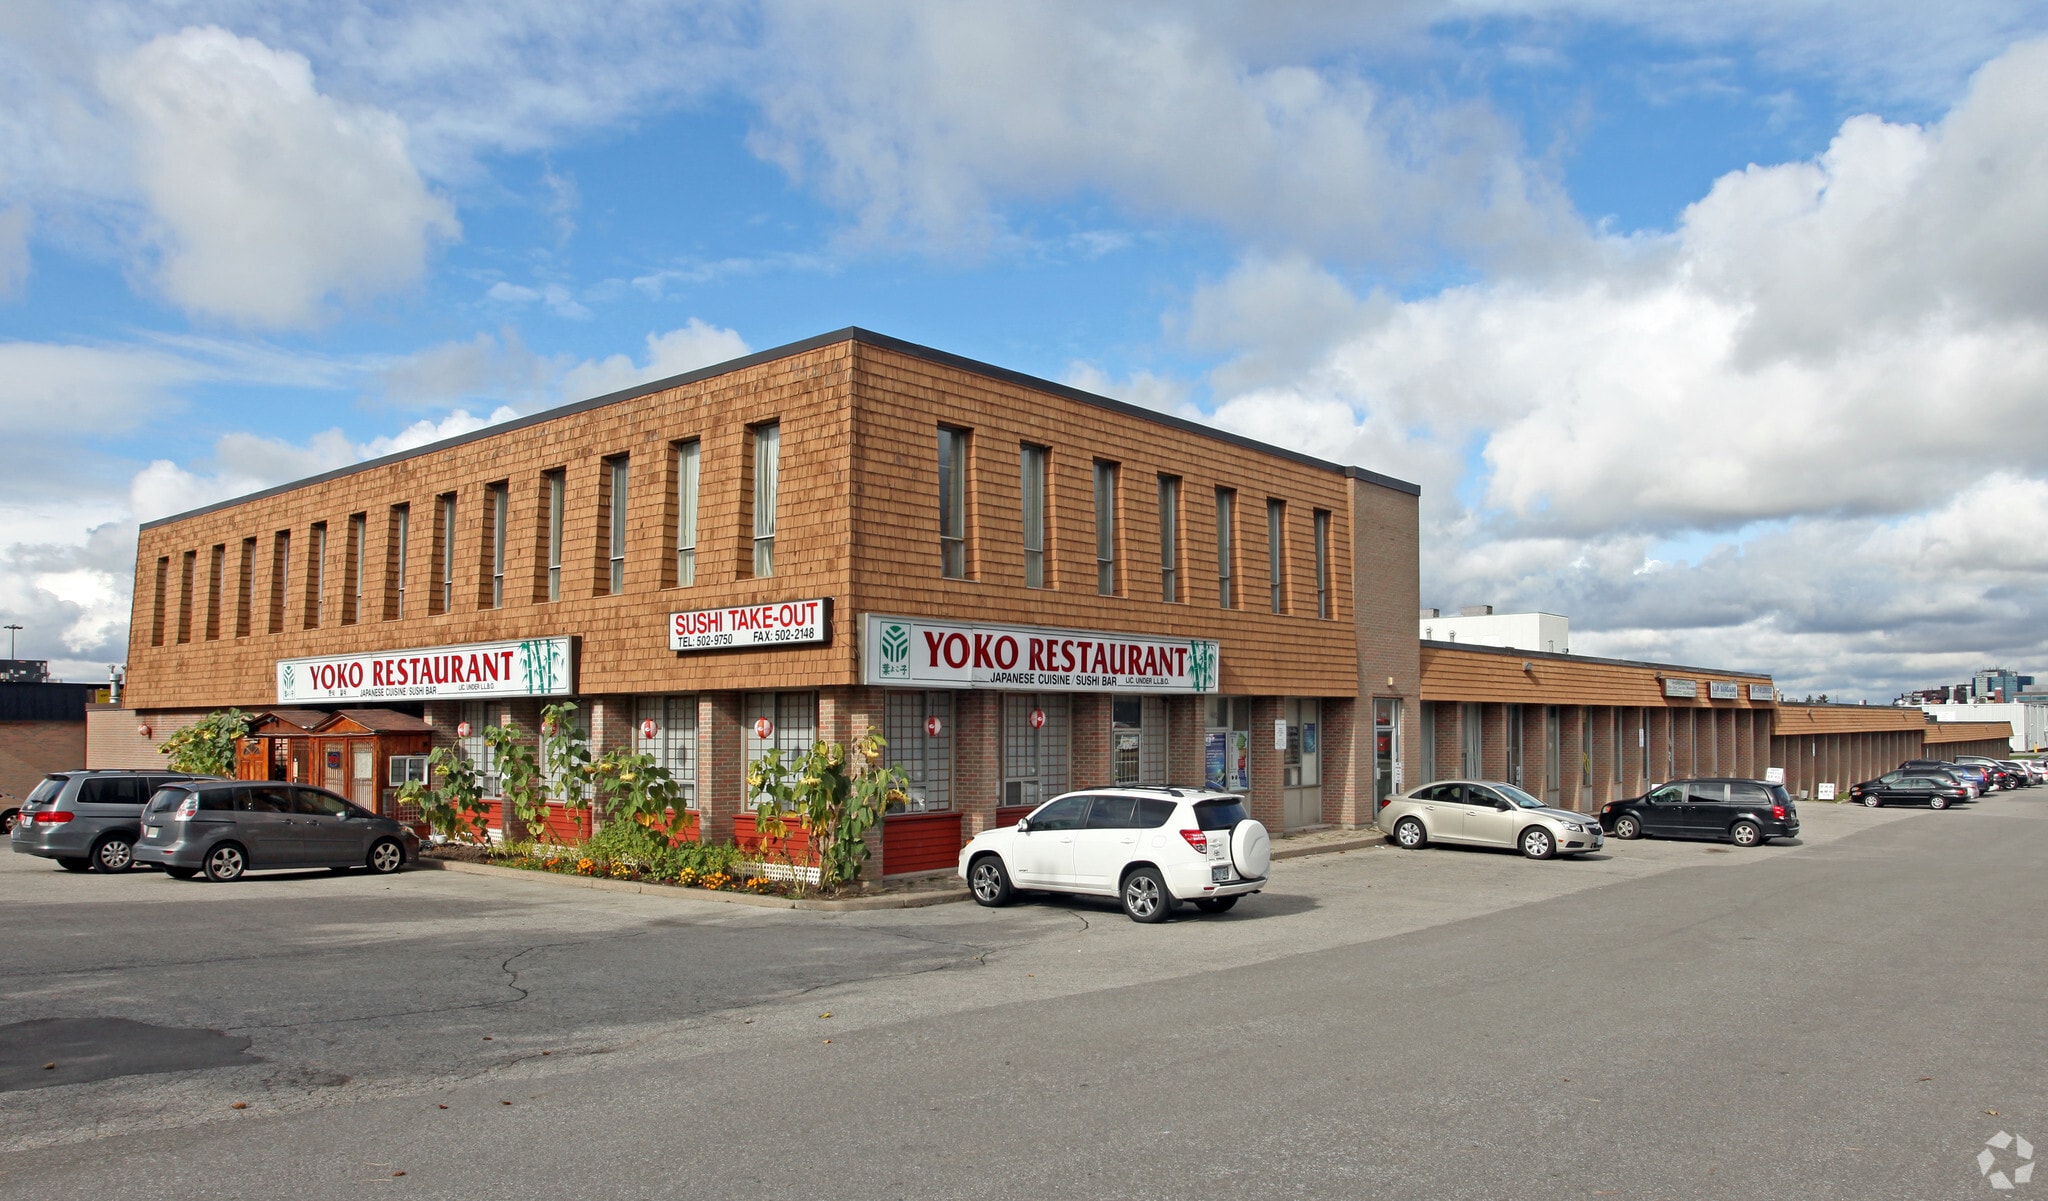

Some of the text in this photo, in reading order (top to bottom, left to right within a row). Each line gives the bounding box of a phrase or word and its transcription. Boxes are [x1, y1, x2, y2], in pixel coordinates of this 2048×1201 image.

[675, 602, 818, 636] SUSHI TAKE-OUT
[678, 628, 815, 648] TEL: 502-9750 FAX: 502-2148
[923, 631, 1188, 677] YOKO RESTAURANT
[310, 651, 514, 690] YOKO RESTAURANT
[990, 672, 1035, 684] JAPANESE
[1102, 675, 1117, 687] BAR
[1136, 677, 1152, 685] UNDER
[360, 688, 384, 697] JAPANESE
[425, 686, 437, 695] BAR
